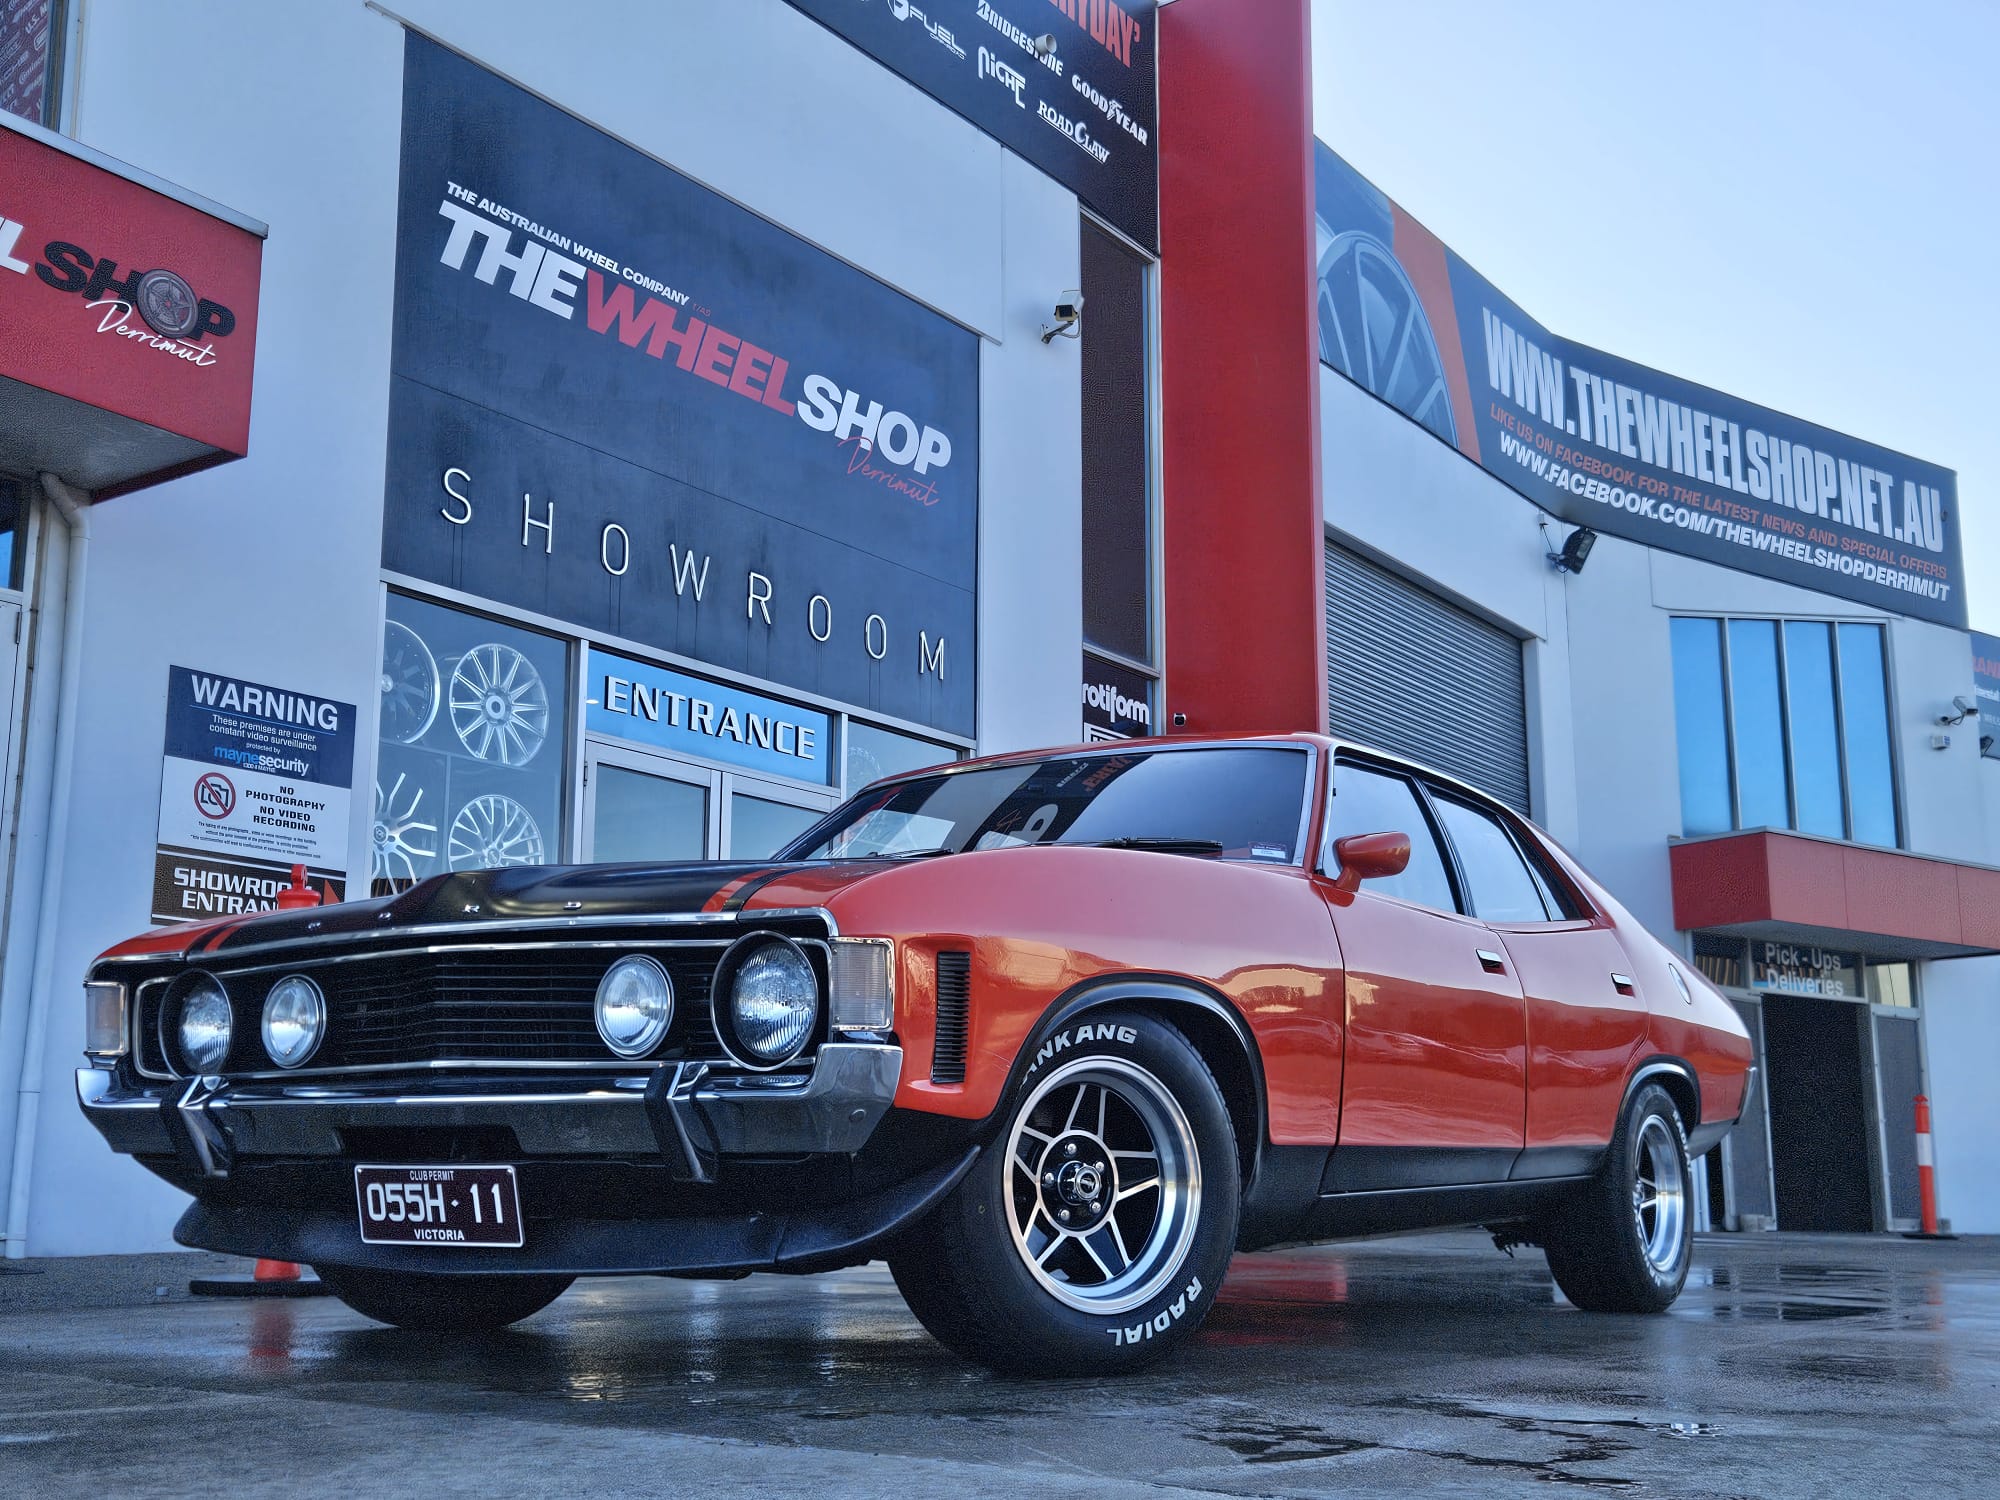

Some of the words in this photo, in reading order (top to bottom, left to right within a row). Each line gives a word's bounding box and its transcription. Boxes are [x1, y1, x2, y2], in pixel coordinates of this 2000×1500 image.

[909, 5, 967, 56] FUEL
[1072, 74, 1148, 146] GOODYEAR
[447, 180, 478, 206] THE
[477, 198, 571, 250] AUSTRALIAN
[573, 242, 620, 275] WHEEL
[622, 267, 690, 306] COMPANY
[85, 300, 216, 367] Derrimut
[438, 199, 587, 320] THE
[587, 268, 796, 417] WHEEL
[797, 374, 952, 475] SHOP
[1482, 306, 1944, 553] WWW.THEWHEELSHOP.NET.AU
[837, 436, 940, 507] Derrimut
[1490, 402, 1514, 432] LIKE
[1517, 420, 1533, 443] US
[1535, 433, 1552, 455] ON
[1555, 444, 1636, 487] FACEBOOK
[1637, 475, 1670, 498] FOR
[1672, 486, 1701, 507] THE
[1703, 495, 1760, 524] LATEST
[1761, 513, 1805, 538] NEWS
[1807, 527, 1838, 547] AND
[1840, 536, 1897, 566] SPECIAL
[1899, 554, 1947, 579] OFFERS
[1500, 431, 1950, 601] WWW.FACEBOOK.COM/THEWHEELSHOPDERRIMUT
[191, 674, 339, 731] WARNING
[603, 674, 816, 760] ENTRANCE
[1082, 683, 1150, 725] rotiform
[209, 724, 245, 738] constant
[247, 731, 269, 742] video
[270, 736, 317, 751] surveillance
[212, 714, 237, 727] These
[239, 721, 276, 735] premises
[278, 728, 291, 738] are
[293, 731, 316, 742] under
[246, 742, 273, 753] protected
[273, 747, 281, 755] by
[245, 790, 325, 811] PHOTOGRAPHY
[279, 786, 294, 795] NO
[253, 815, 316, 832] RECORDING
[260, 806, 274, 815] NO
[279, 808, 311, 822] VIDEO
[174, 867, 312, 899] SHOWROO
[182, 890, 278, 915] ENTRAN
[1765, 942, 1799, 967] Pick
[1811, 948, 1842, 974] Ups
[1767, 968, 1844, 997] Deliveries
[409, 1170, 428, 1181] CLUB
[428, 1170, 455, 1182] PERMIT
[413, 1228, 465, 1241] VICTORIA
[1106, 1276, 1203, 1346] RADIAL
